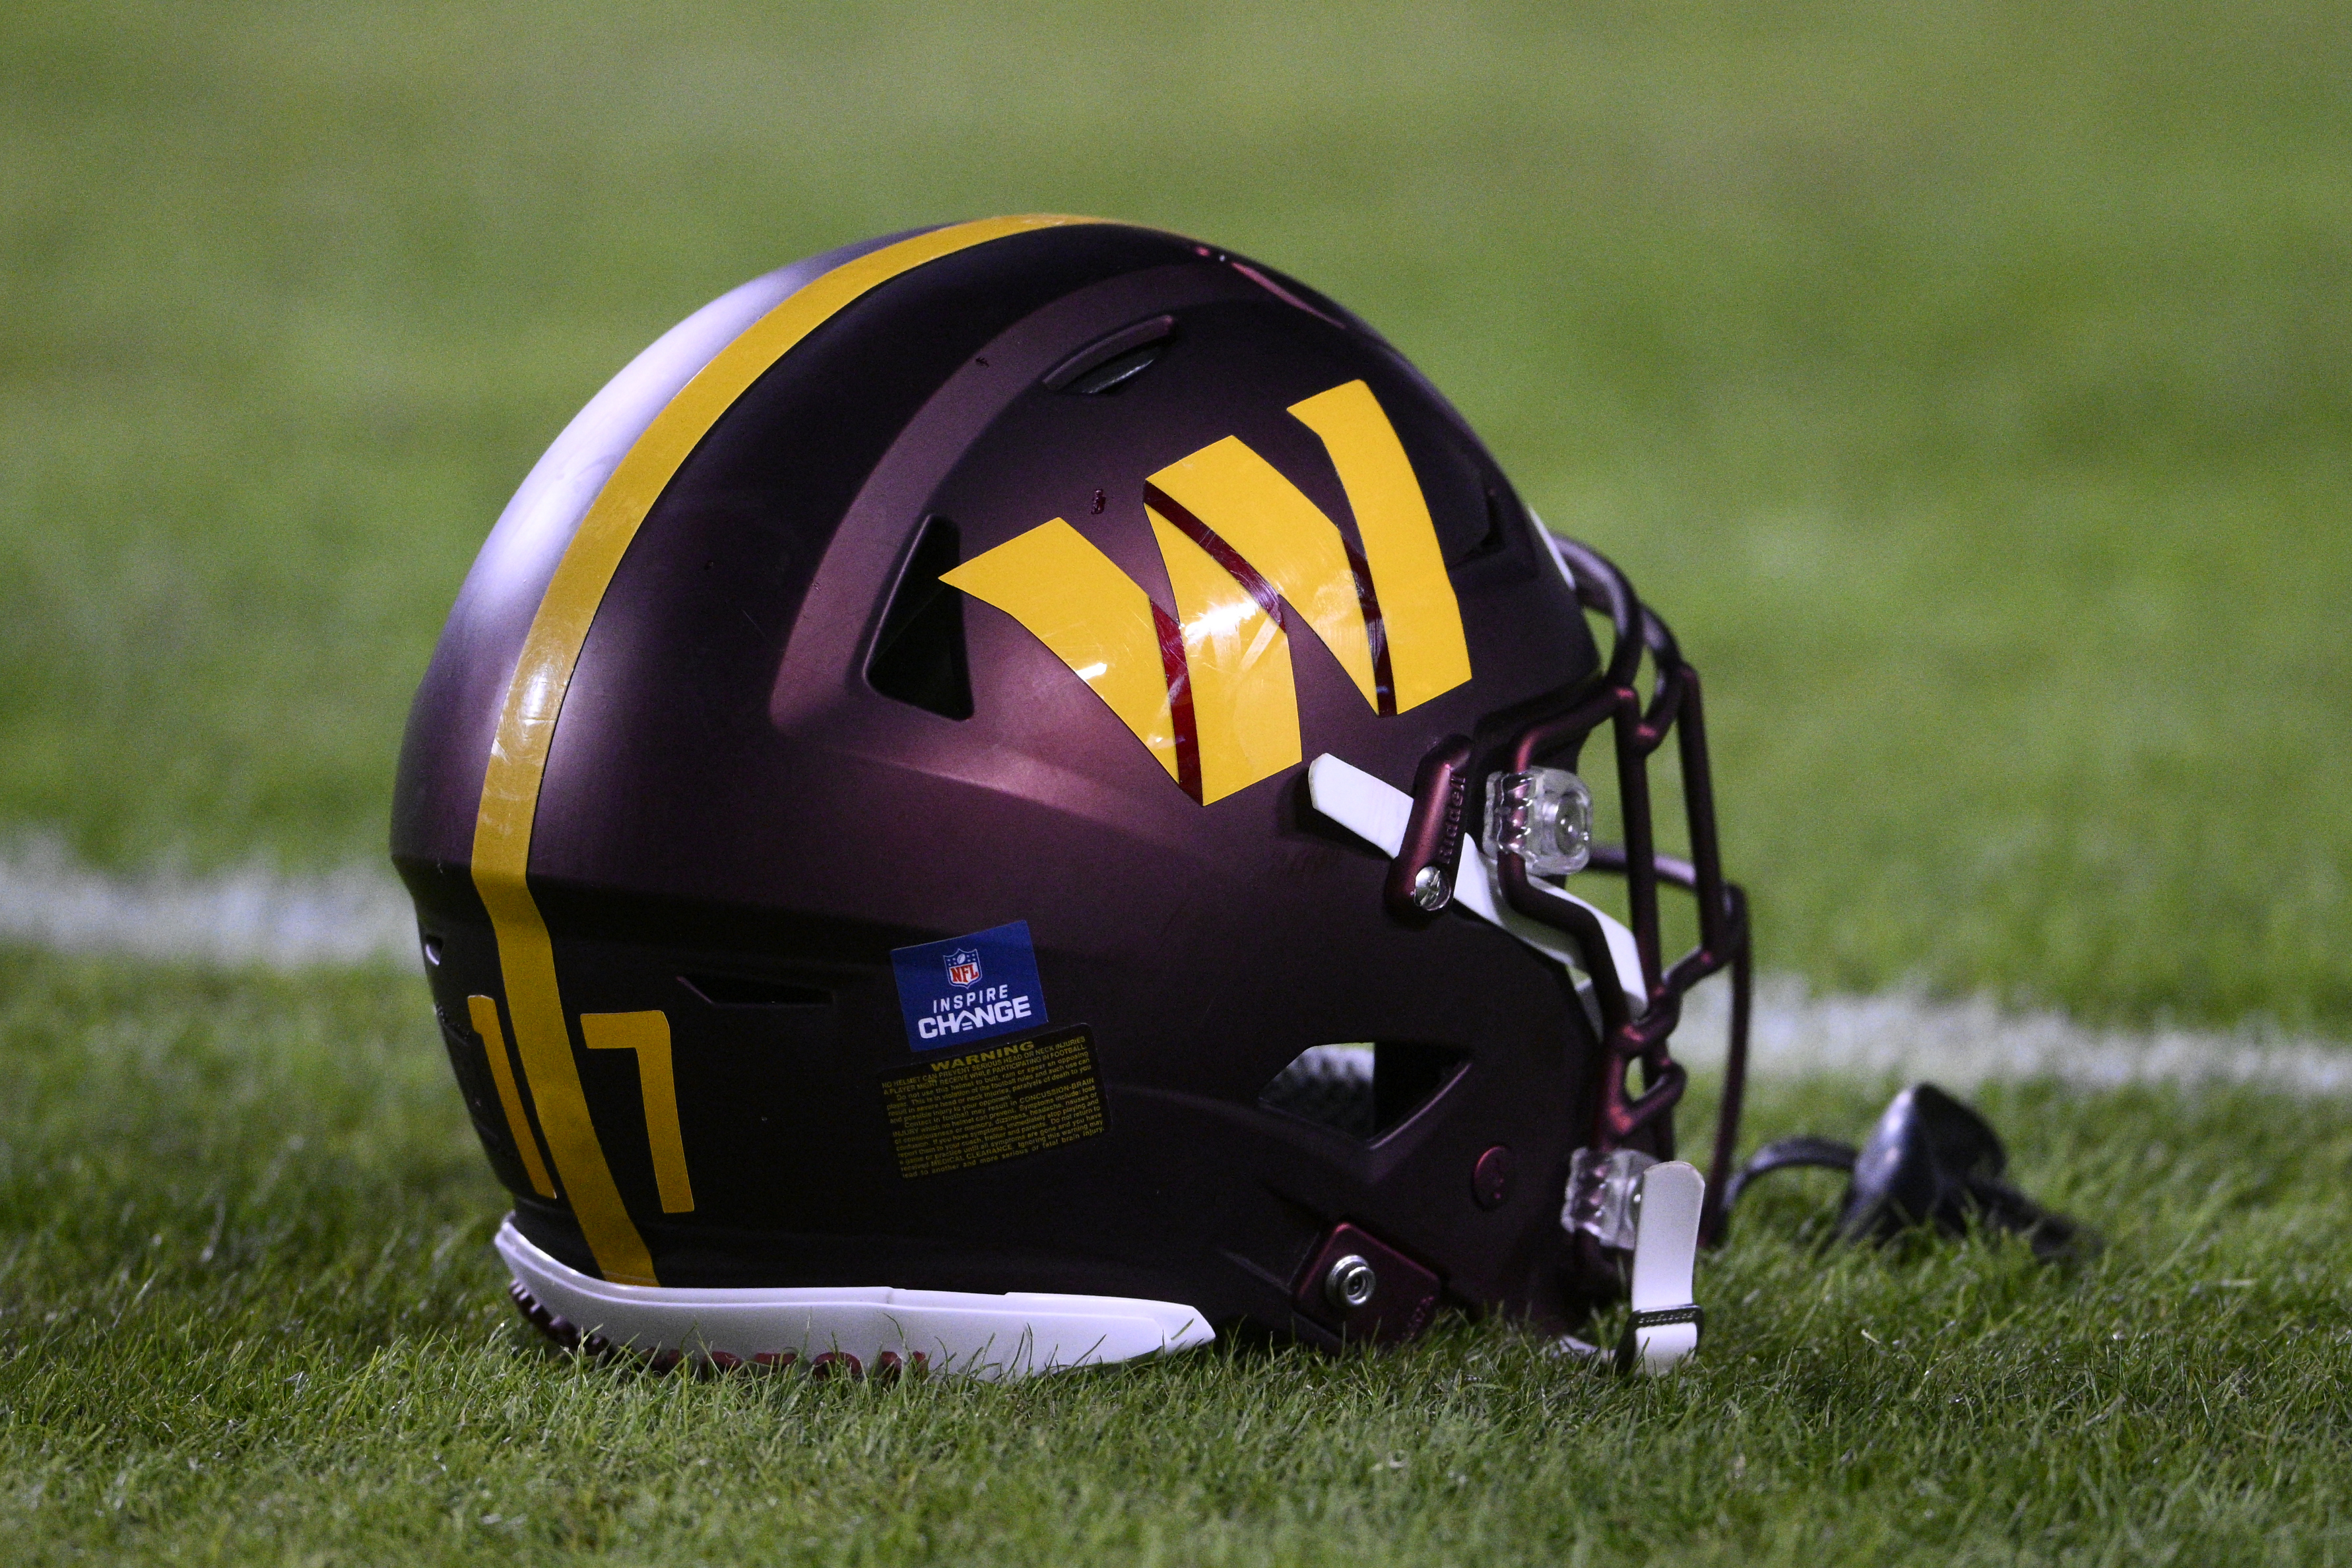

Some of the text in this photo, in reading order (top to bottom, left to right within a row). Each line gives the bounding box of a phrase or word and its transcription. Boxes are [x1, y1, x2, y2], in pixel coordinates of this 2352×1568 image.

[950, 964, 979, 983] NFL
[933, 984, 1008, 1013] INSPIRE
[918, 995, 1031, 1039] CHANGE
[931, 1041, 1035, 1072] WARNING
[938, 1066, 970, 1077] PREVENT
[971, 1059, 1002, 1070] SERIOUS
[1003, 1053, 1022, 1063] HEAD
[1035, 1045, 1054, 1055] NECK
[1055, 1035, 1085, 1049] INJURIES
[940, 1074, 968, 1085] RECEIVE
[969, 1068, 991, 1078] WHILE
[992, 1056, 1041, 1073] PARTICIPATING
[950, 1081, 973, 1090] helmet
[1027, 1064, 1045, 1072] spear
[1057, 1052, 1088, 1064] opposing
[942, 1089, 969, 1099] violation
[991, 1078, 1016, 1088] football
[1049, 1064, 1064, 1073] such
[1012, 1079, 1042, 1092] paralysis
[1051, 1070, 1070, 1080] death
[1079, 1065, 1091, 1074] you
[942, 1111, 969, 1121] football
[988, 1101, 1008, 1111] result
[1019, 1077, 1094, 1103] CONCUSSION-BRAIN
[1065, 1095, 1089, 1105] nausea
[1074, 1109, 1093, 1117] return
[892, 1127, 919, 1136] INJURY
[951, 1117, 974, 1126] helmet
[1019, 1098, 1054, 1111] Symptoms
[903, 1112, 931, 1122] possible
[1006, 1115, 1046, 1128] immediately
[1062, 1103, 1086, 1115] playing
[931, 1154, 964, 1166] MEDICAL
[1018, 1136, 1046, 1148] Ignoring
[1062, 1125, 1088, 1135] warning
[932, 1163, 959, 1173] another
[1002, 1148, 1028, 1158] serious
[1042, 1138, 1058, 1148] fatal
[1061, 1134, 1080, 1142] brain
[934, 1149, 962, 1159] practice
[990, 1135, 1025, 1146] symptoms
[1039, 1127, 1056, 1135] gone
